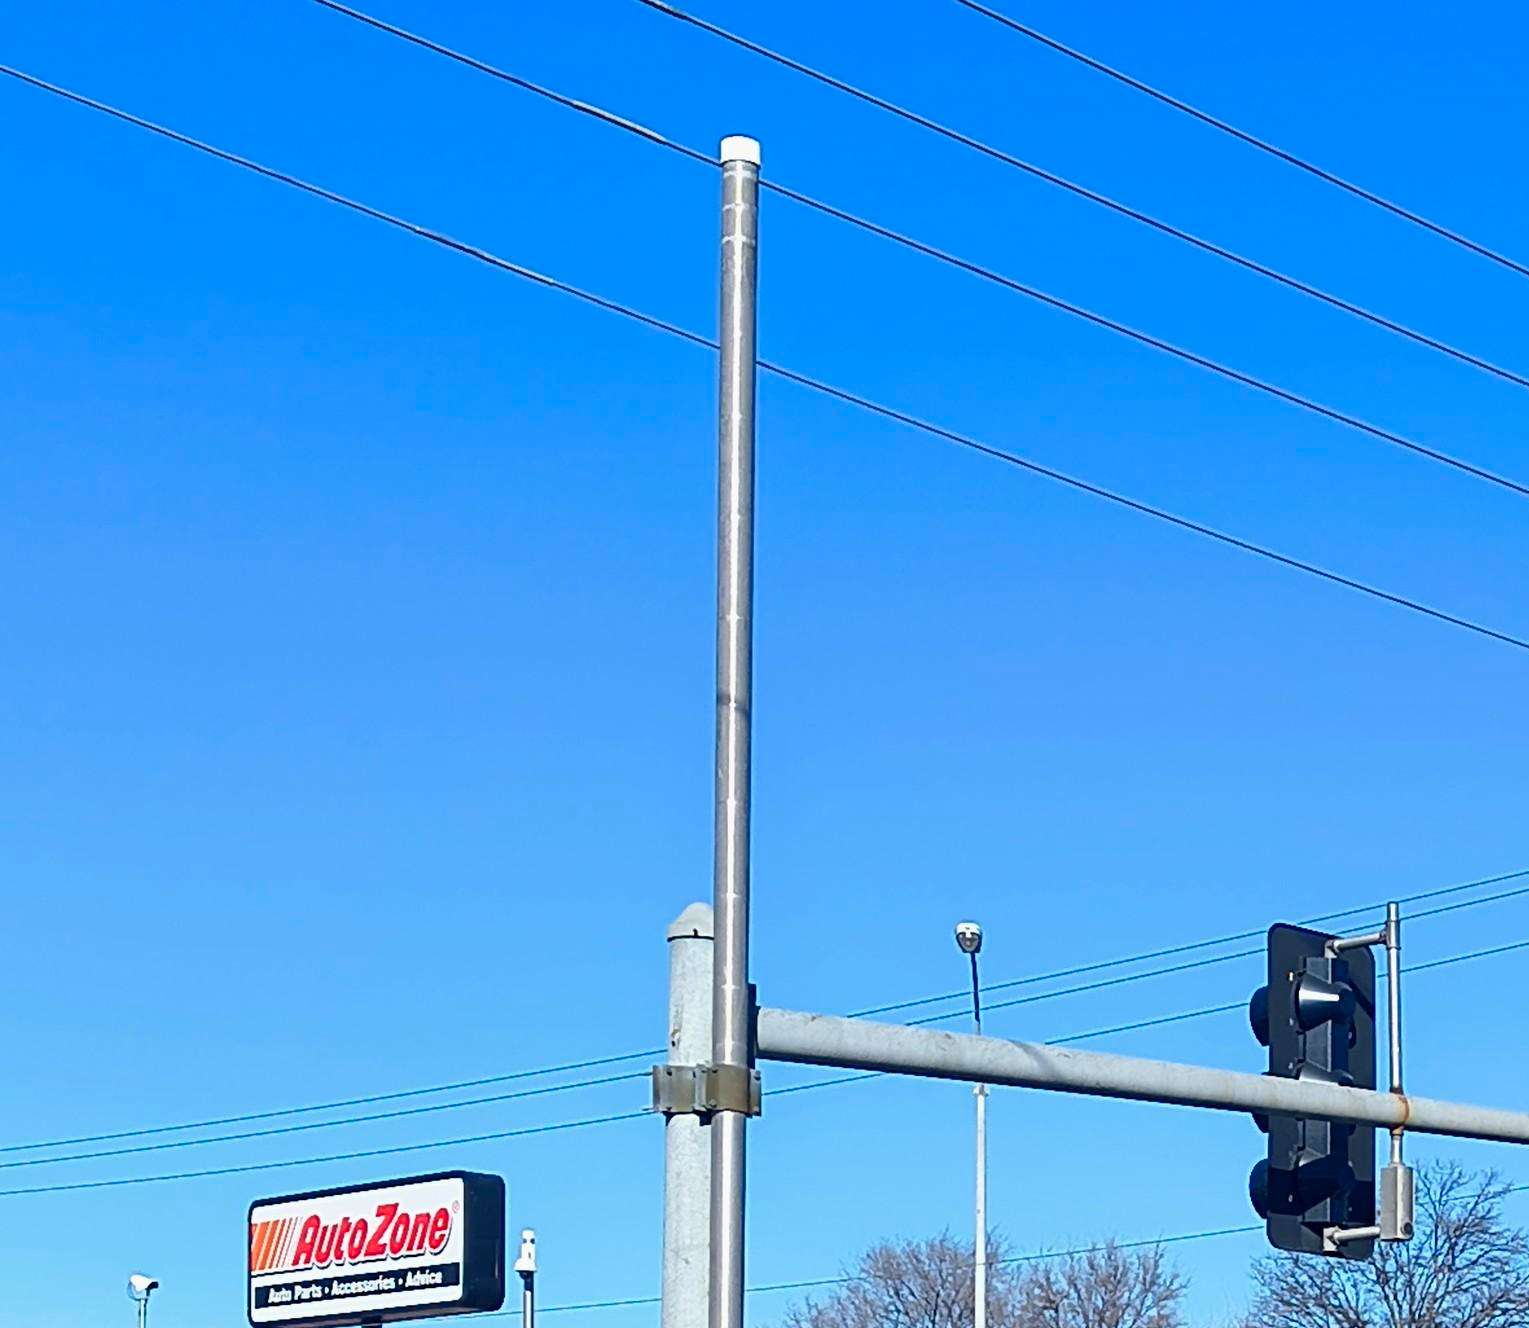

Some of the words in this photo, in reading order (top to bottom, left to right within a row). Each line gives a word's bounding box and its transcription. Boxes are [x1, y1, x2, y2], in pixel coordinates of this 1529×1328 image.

[291, 1202, 451, 1268] AutoZone
[268, 1287, 292, 1304] Auto
[294, 1281, 323, 1300] Parts
[331, 1275, 396, 1297] Accessories
[405, 1269, 443, 1288] Advice
